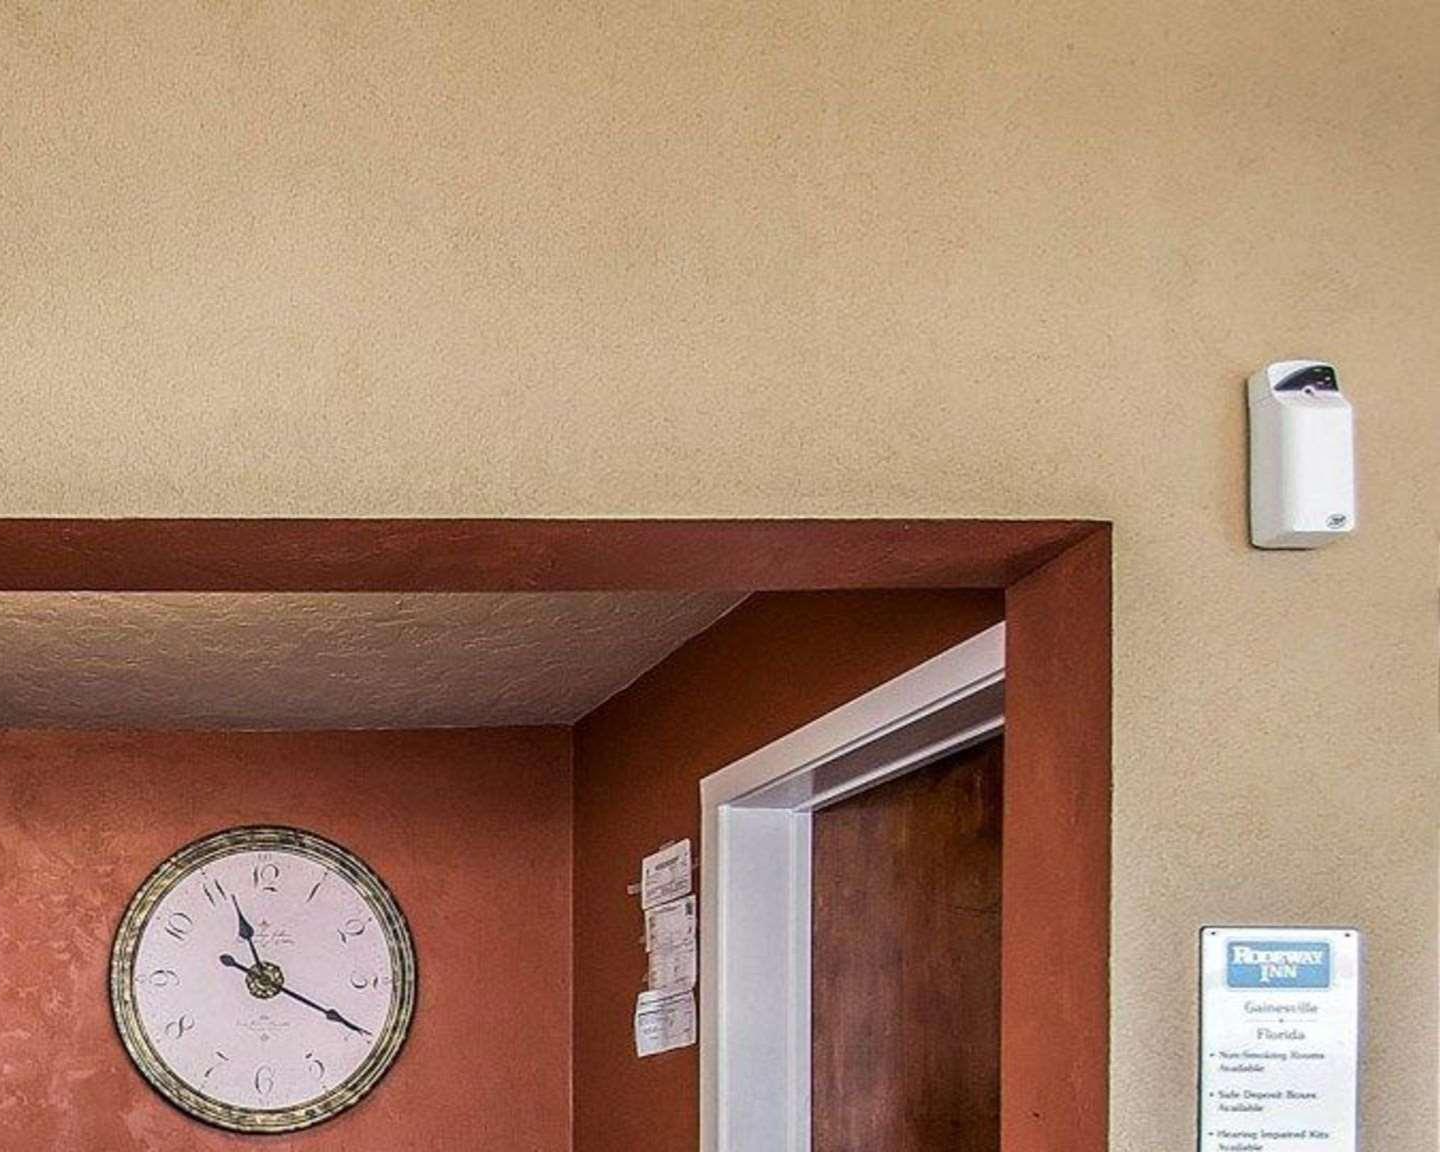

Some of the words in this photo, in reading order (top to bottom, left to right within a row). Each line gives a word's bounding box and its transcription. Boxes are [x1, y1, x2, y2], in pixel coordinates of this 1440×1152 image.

[253, 864, 279, 892] 12
[203, 878, 227, 907] 11
[306, 882, 321, 903] 1
[164, 912, 193, 940] 10
[337, 917, 366, 943] 2
[149, 969, 179, 987] 9
[351, 975, 378, 989] 3
[1244, 1001, 1318, 1013] Gainesville
[164, 1014, 195, 1040] 8
[1256, 1029, 1305, 1040] Florida
[204, 1051, 229, 1078] 7
[305, 1052, 326, 1079] 5
[255, 1065, 275, 1095] 6
[1243, 1091, 1282, 1099] Deposit
[1217, 1130, 1257, 1139] Hearing
[1260, 1130, 1306, 1139] Impaired
[1219, 1143, 1263, 1151] Available
